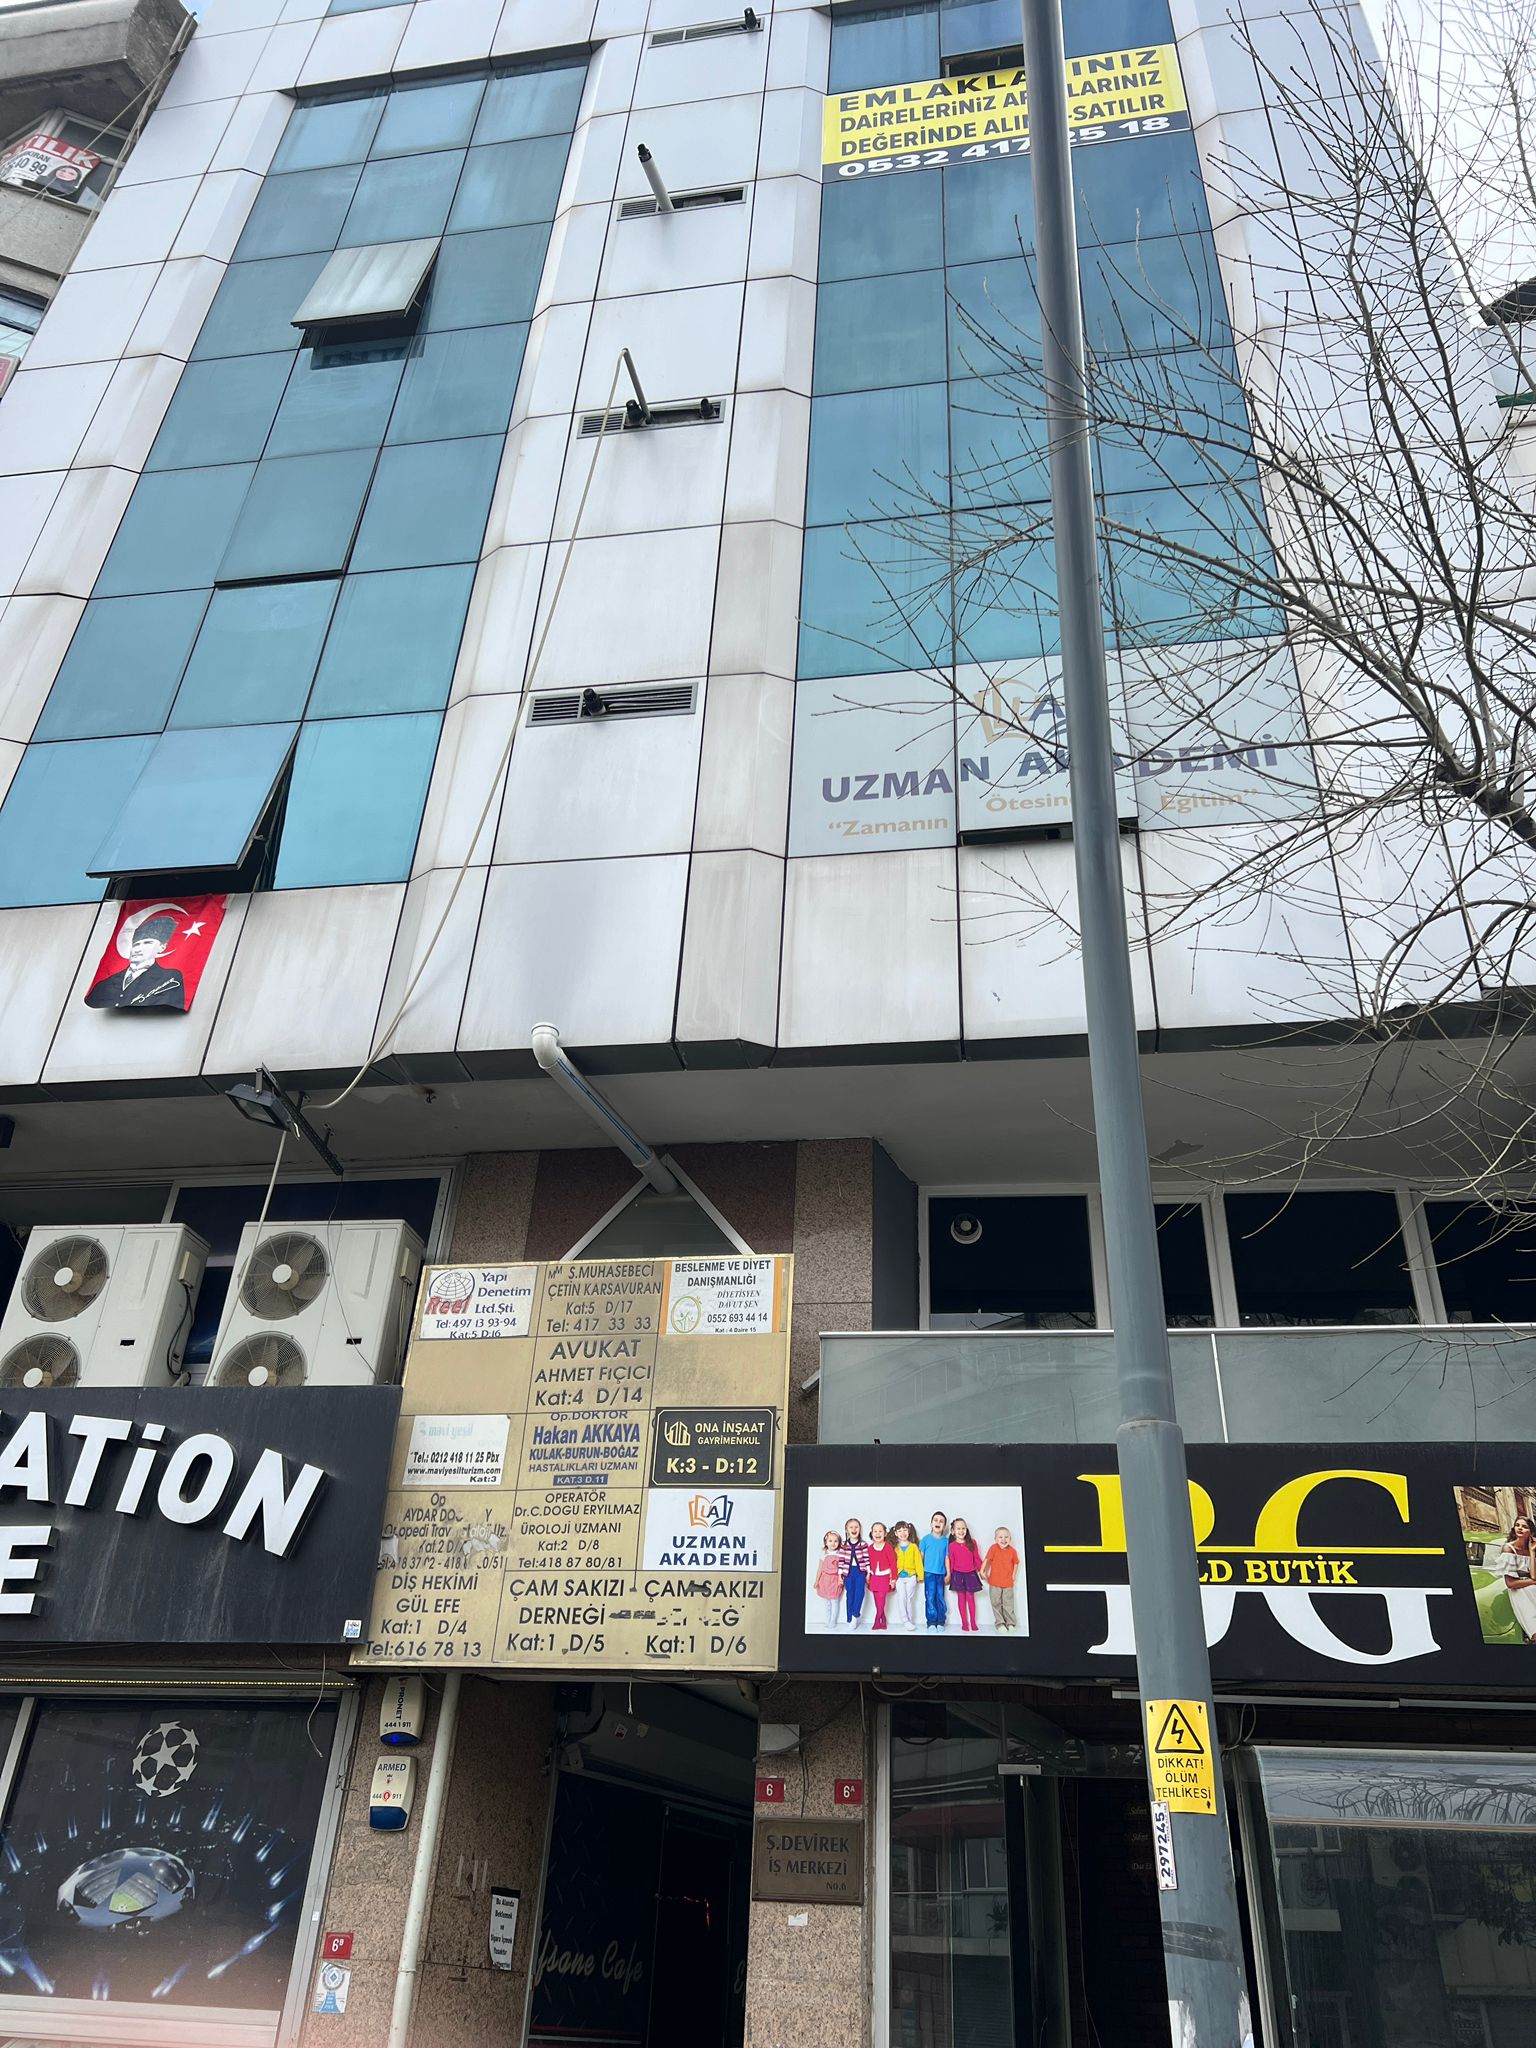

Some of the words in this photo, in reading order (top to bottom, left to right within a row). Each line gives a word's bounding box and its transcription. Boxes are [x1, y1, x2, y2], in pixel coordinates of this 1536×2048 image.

[840, 50, 1159, 112] EMLAKLAINIZ
[838, 150, 949, 177] 0532
[961, 137, 1031, 158] 417
[1119, 116, 1170, 134] 18
[841, 122, 976, 157] DEĞERİNDE
[29, 161, 47, 175] 99
[822, 756, 990, 803] UZMAN
[1017, 733, 1278, 778] ADEMİ
[675, 1261, 725, 1273] BESLENME
[728, 1261, 740, 1271] VE
[743, 1258, 771, 1270] DİYET
[481, 1272, 508, 1284] Yapı
[687, 1274, 756, 1288] DANIŞMANLIĞI
[478, 1287, 531, 1297] Denetim
[548, 1281, 581, 1301] ÇETİN
[584, 1281, 661, 1296] KARSAVURAN
[717, 1289, 761, 1299] DİYETİSYEN
[424, 1295, 472, 1315] Reel
[475, 1302, 515, 1315] Ltd.Şti.
[566, 1301, 595, 1315] Kat:5
[605, 1301, 633, 1315] D/17
[744, 1300, 760, 1310] ŞEN
[436, 1319, 451, 1328] Tel:
[452, 1318, 472, 1328] 497
[475, 1318, 484, 1327] 13
[488, 1317, 516, 1327] 93-94
[547, 1319, 569, 1332] Tel:
[573, 1318, 599, 1331] 417
[608, 1317, 625, 1331] 33
[634, 1316, 651, 1330] 33
[707, 1314, 727, 1323] 0552
[729, 1313, 744, 1323] 693
[746, 1313, 756, 1322] 44
[759, 1313, 768, 1322] 14
[550, 1339, 641, 1360] AVUKAT
[535, 1367, 595, 1383] AHMET
[599, 1365, 651, 1384] FIÇICI
[535, 1389, 584, 1406] Kat:4
[596, 1387, 643, 1406] D/14
[550, 1410, 628, 1422] Op.DOKTOR
[532, 1425, 578, 1445] Hakan
[581, 1423, 640, 1443] AKKAYA
[695, 1422, 719, 1433] ONA
[722, 1420, 765, 1435] İNŞAAT
[697, 1435, 760, 1445] GAYRİMENKUL
[430, 1452, 449, 1463] 0212
[450, 1452, 463, 1463] 418
[465, 1452, 474, 1463] 11
[475, 1452, 485, 1463] 25
[486, 1451, 500, 1463] Pbx
[529, 1462, 598, 1472] HASTALIKLARI
[600, 1461, 638, 1471] UZMANI
[666, 1457, 696, 1474] K:3
[715, 1457, 758, 1474] D:12
[431, 1492, 446, 1508] Op
[544, 1489, 606, 1503] OPERATÖR
[403, 1508, 437, 1522] AYDAR
[583, 1504, 640, 1515] ERYILMAZ
[520, 1521, 570, 1535] ÜROLOJİ
[574, 1522, 621, 1534] UZMANI
[538, 1540, 568, 1551] Kat:2
[578, 1539, 600, 1552] D/8
[672, 1535, 746, 1549] UZMAN
[518, 1557, 562, 1569] Tel:418
[566, 1557, 582, 1568] 87
[586, 1557, 622, 1569] 80/81
[659, 1550, 758, 1566] AKADEMİ
[1246, 1554, 1358, 1584] BUTİK
[391, 1572, 417, 1592] DİŞ
[422, 1572, 479, 1590] HEKİMİ
[510, 1579, 559, 1601] ÇAM
[564, 1579, 625, 1597] SAKIZI
[644, 1580, 695, 1603] ÇAM
[701, 1580, 764, 1598] SAKIZI
[396, 1594, 429, 1613] GÜL
[434, 1598, 461, 1613] EFE
[519, 1603, 605, 1625] DERNEĞİ
[381, 1620, 422, 1634] Kat:1
[438, 1620, 467, 1637] D/4
[366, 1641, 427, 1656] Tel:616
[433, 1641, 454, 1657] 78
[463, 1642, 482, 1657] 13
[507, 1633, 555, 1651] Kat:1
[569, 1634, 605, 1655] D/5
[646, 1635, 695, 1653] Kat:1
[711, 1635, 747, 1656] D/6
[395, 1686, 406, 1720] PRONET
[377, 1763, 407, 1772] ARMED
[1158, 1756, 1204, 1770] DİKKAT!
[1165, 1770, 1198, 1784] ÖLÜM
[766, 1783, 773, 1797] 6
[1156, 1785, 1211, 1800] TEHLİKESİ
[766, 1833, 850, 1855] Ş.DEVİREK
[1155, 1811, 1172, 1878] 297245
[768, 1856, 781, 1876] İŞ
[786, 1859, 847, 1876] MERKEZİ
[535, 1928, 596, 1987] fsane
